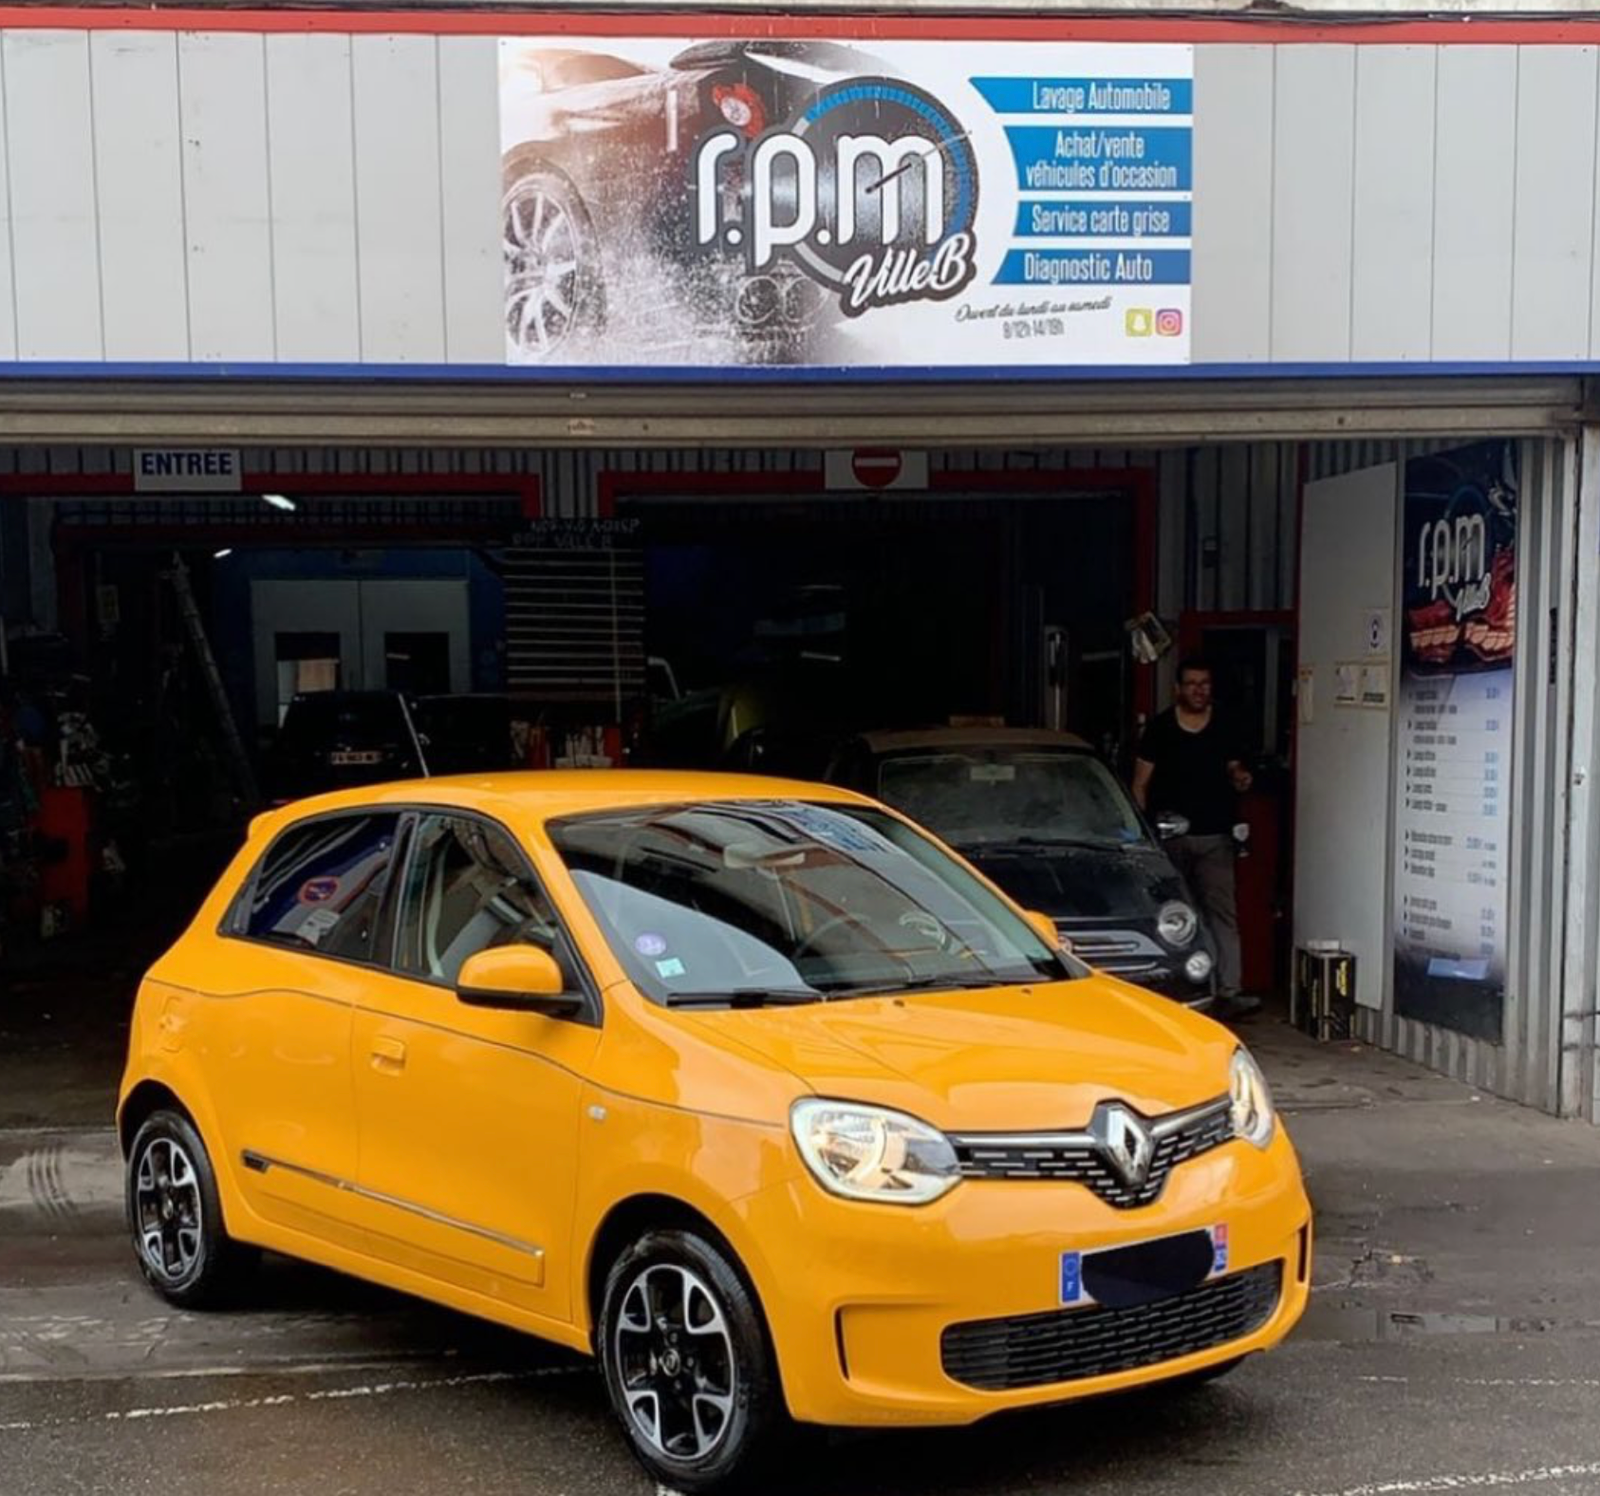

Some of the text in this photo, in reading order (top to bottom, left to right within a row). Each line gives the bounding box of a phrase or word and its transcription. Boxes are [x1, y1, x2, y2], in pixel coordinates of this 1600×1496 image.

[1032, 82, 1171, 113] Lavage Automobile
[1055, 131, 1145, 159] Achat/vente
[1026, 161, 1178, 188] véhicules d'occasion
[1032, 205, 1171, 237] Service carte grise
[1024, 253, 1153, 284] Diagnostic Auto
[956, 304, 999, 322] Ouvert
[998, 303, 1014, 317] du
